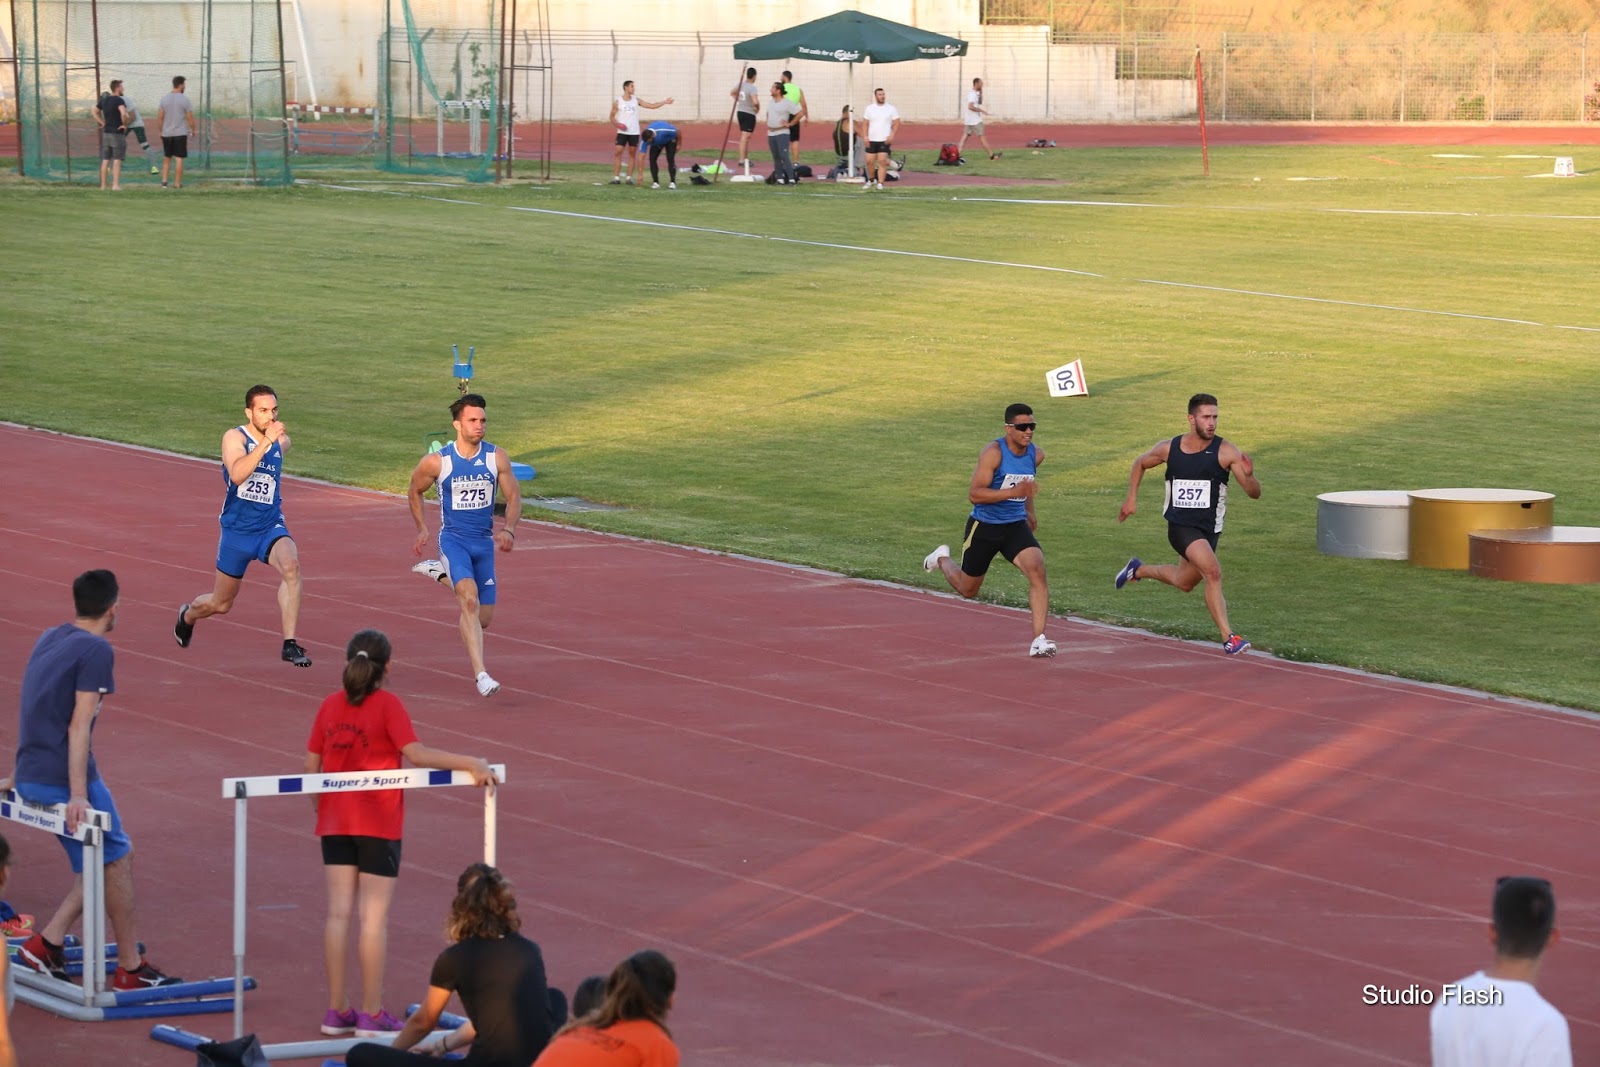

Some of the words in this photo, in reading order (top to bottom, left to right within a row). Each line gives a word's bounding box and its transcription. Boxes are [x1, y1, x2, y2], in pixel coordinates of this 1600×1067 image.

[1056, 370, 1075, 391] 50
[247, 481, 269, 495] 253
[1178, 488, 1203, 500] 257
[460, 489, 486, 501] 275
[322, 778, 361, 788] Super
[372, 776, 410, 786] Sport
